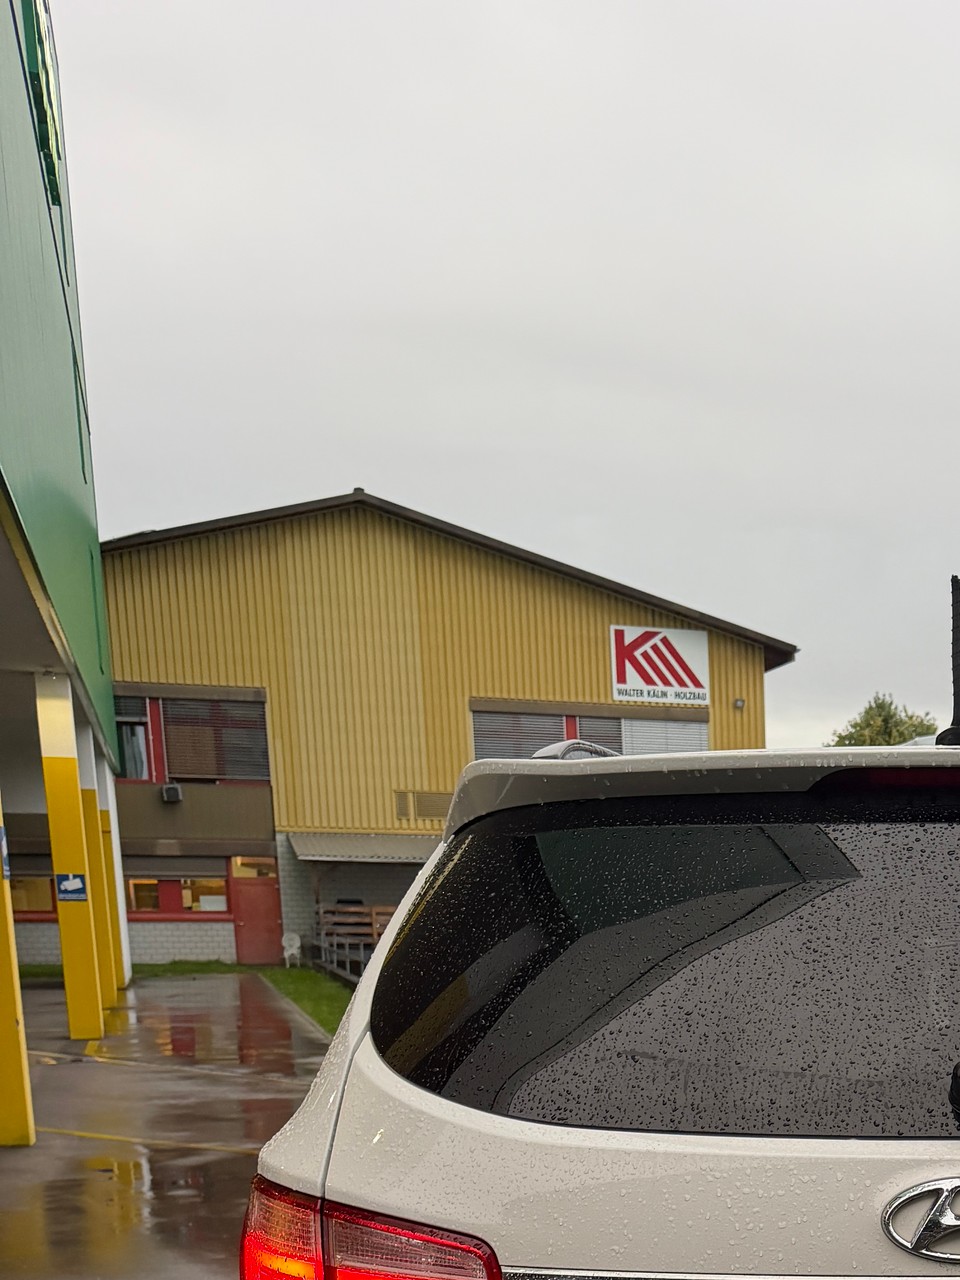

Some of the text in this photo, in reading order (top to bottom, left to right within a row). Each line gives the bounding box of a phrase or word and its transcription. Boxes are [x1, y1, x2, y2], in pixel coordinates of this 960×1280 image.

[616, 688, 707, 701] WALTER KÄLIN HOLZBAU
